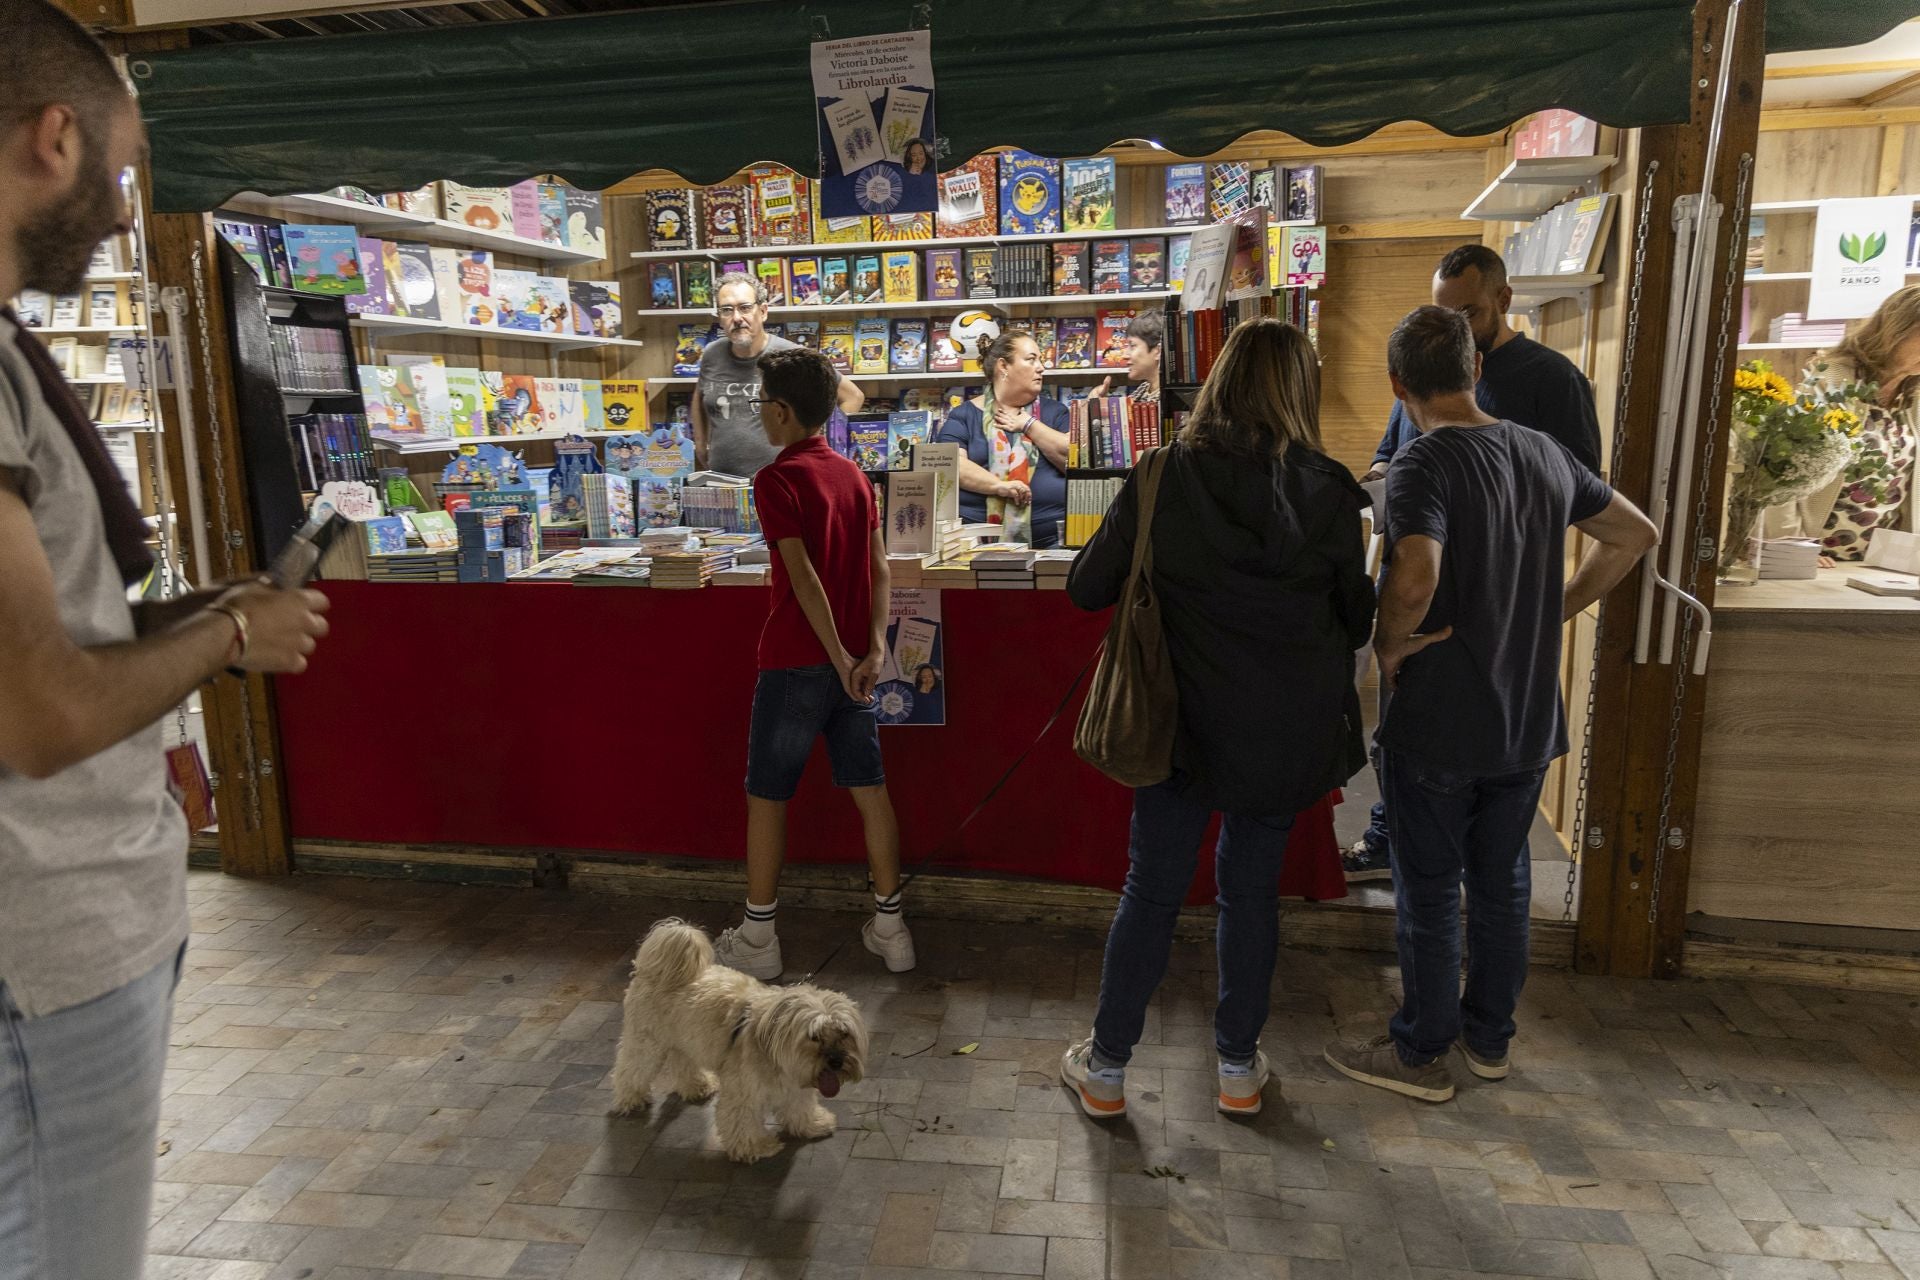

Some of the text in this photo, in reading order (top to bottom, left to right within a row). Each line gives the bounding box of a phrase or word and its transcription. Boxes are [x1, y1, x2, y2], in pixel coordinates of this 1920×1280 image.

[882, 45, 907, 53] octubre
[830, 53, 908, 70] Victoria Daboise
[838, 73, 908, 90] Librolandia
[1171, 165, 1203, 178] FORTNITE
[948, 181, 978, 193] WALLY
[1292, 241, 1321, 258] GOA
[1064, 256, 1077, 264] LOS
[1841, 266, 1880, 274] EDITORIAL
[1061, 278, 1081, 286] PLATA
[1840, 275, 1881, 284] PANDO
[889, 606, 917, 616] andia
